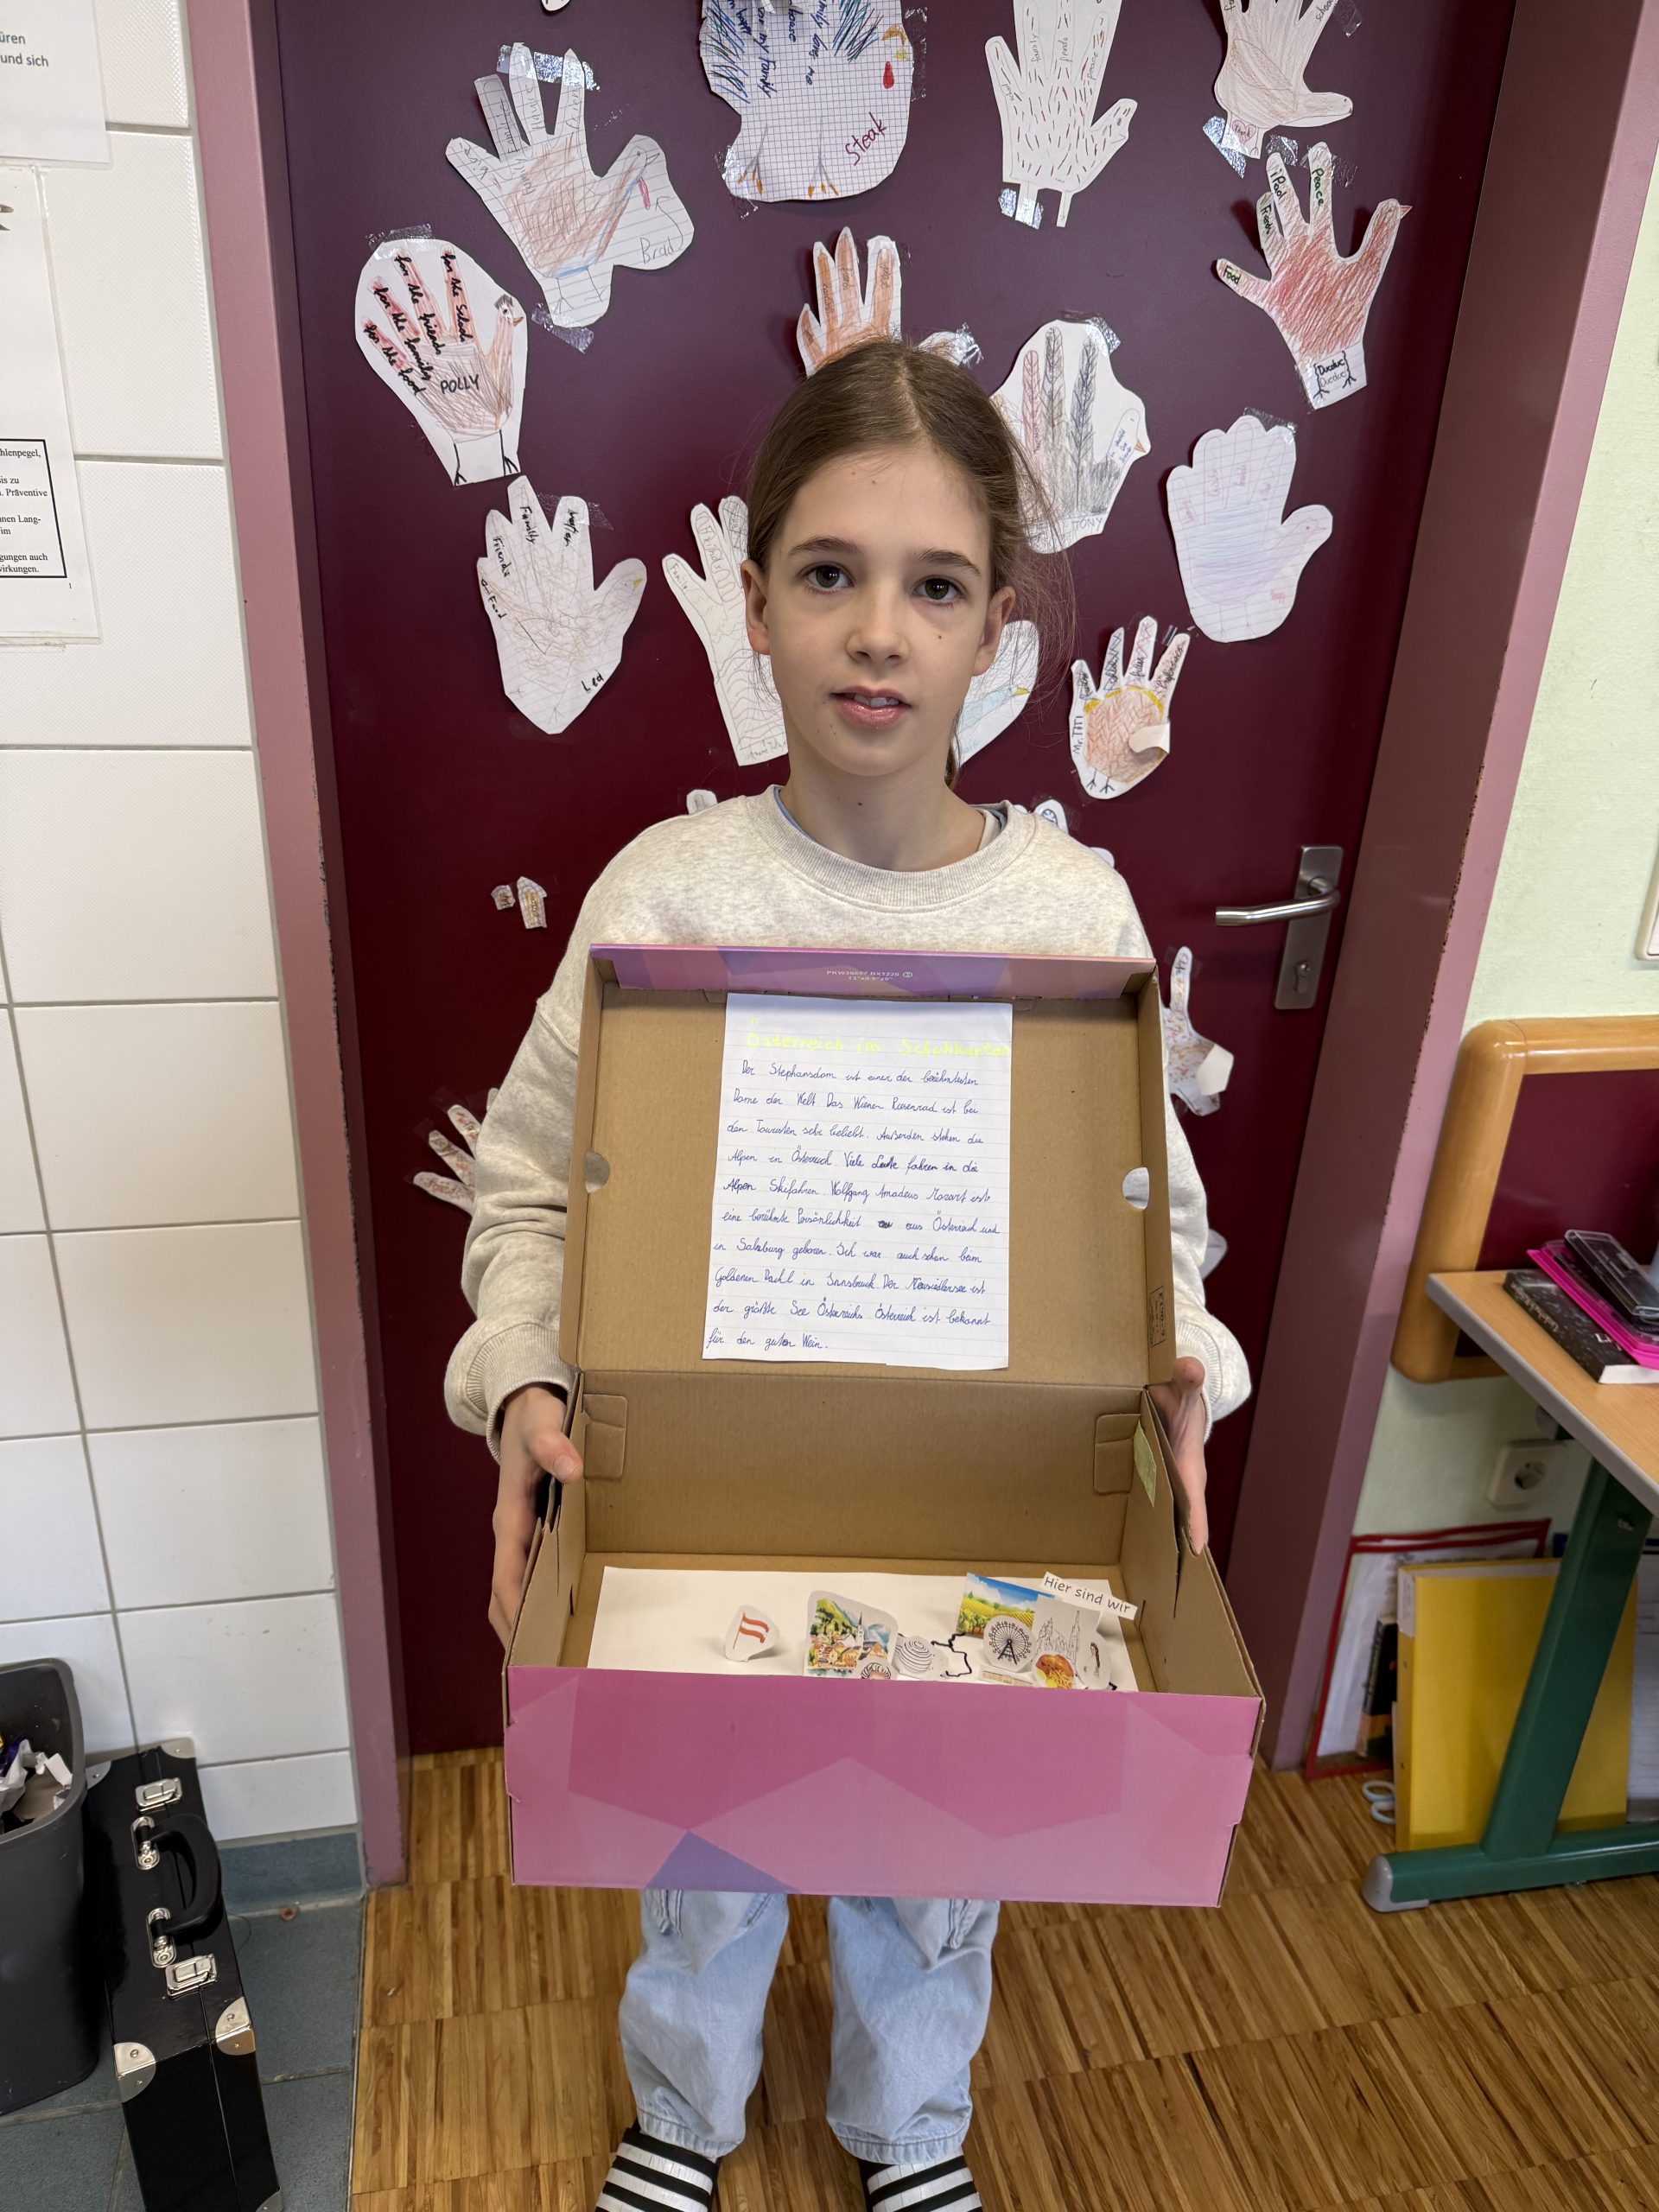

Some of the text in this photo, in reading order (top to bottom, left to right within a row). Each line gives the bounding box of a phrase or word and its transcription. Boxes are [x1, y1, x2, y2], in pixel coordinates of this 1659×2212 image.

[787, 8, 804, 42] house
[753, 32, 770, 54] my
[1029, 34, 1042, 66] family
[0, 53, 49, 67] und sich
[758, 56, 778, 99] Family
[845, 111, 887, 166] Steak
[1270, 168, 1287, 200] iPad
[1312, 168, 1325, 207] Peace
[639, 236, 674, 264] Brad
[450, 277, 462, 297] the
[1224, 265, 1242, 286] Food
[391, 311, 407, 332] the
[408, 283, 423, 305] the
[418, 313, 446, 355] friends
[382, 346, 398, 366] the
[398, 367, 427, 396] food
[440, 374, 480, 394] POLLY
[6, 488, 48, 498] Präventive
[0, 526, 11, 535] im
[17, 515, 41, 525] Lang-
[1071, 517, 1103, 532] TONY
[29, 552, 48, 561] auch
[856, 1037, 880, 1055] im
[741, 1059, 979, 1085] Der Stephansdom ist einer der berühmtesten
[766, 1092, 784, 1105] der
[797, 1091, 817, 1107] Welt
[826, 1091, 843, 1109] Das
[854, 1095, 884, 1110] Wiener
[891, 1096, 938, 1113] Riesenrad
[942, 1100, 957, 1114] ist
[963, 1099, 979, 1114] bei
[727, 1120, 748, 1133] den
[756, 1119, 797, 1136] Touristen
[802, 1123, 823, 1136] sehr
[931, 1128, 960, 1143] stehen
[967, 1132, 984, 1144] die
[728, 1148, 758, 1166] Alpen
[767, 1154, 783, 1164] in
[843, 1150, 865, 1167] Viele
[905, 1155, 938, 1175] fahren
[943, 1161, 957, 1172] in
[962, 1160, 979, 1173] die
[723, 1179, 757, 1195] Alpen
[830, 1179, 870, 1204] Wolfgang
[874, 1184, 918, 1200] Amadeus
[926, 1187, 968, 1204] Mozart
[970, 1188, 991, 1203] ist
[721, 1208, 742, 1222] eine
[748, 1207, 790, 1224] berühmte
[798, 1207, 861, 1227] Persönlichkeit
[906, 1222, 923, 1230] aus
[980, 1224, 1001, 1234] und
[713, 1237, 727, 1250] in
[736, 1237, 785, 1260] Salzburg
[836, 1242, 857, 1257] Ich
[862, 1250, 881, 1259] war
[896, 1248, 919, 1260] auch
[922, 1246, 950, 1262] schon
[958, 1246, 982, 1263] beim
[715, 1266, 759, 1287] Goldenen
[799, 1272, 815, 1286] in
[882, 1274, 899, 1290] Der
[970, 1278, 987, 1294] ist
[713, 1299, 734, 1313] der
[744, 1300, 777, 1319] größte
[790, 1300, 810, 1316] See
[922, 1306, 941, 1325] ist
[945, 1308, 991, 1325] bekannt
[706, 1327, 725, 1349] für
[736, 1331, 755, 1345] den
[1044, 1576, 1130, 1613] Hier sind wir
